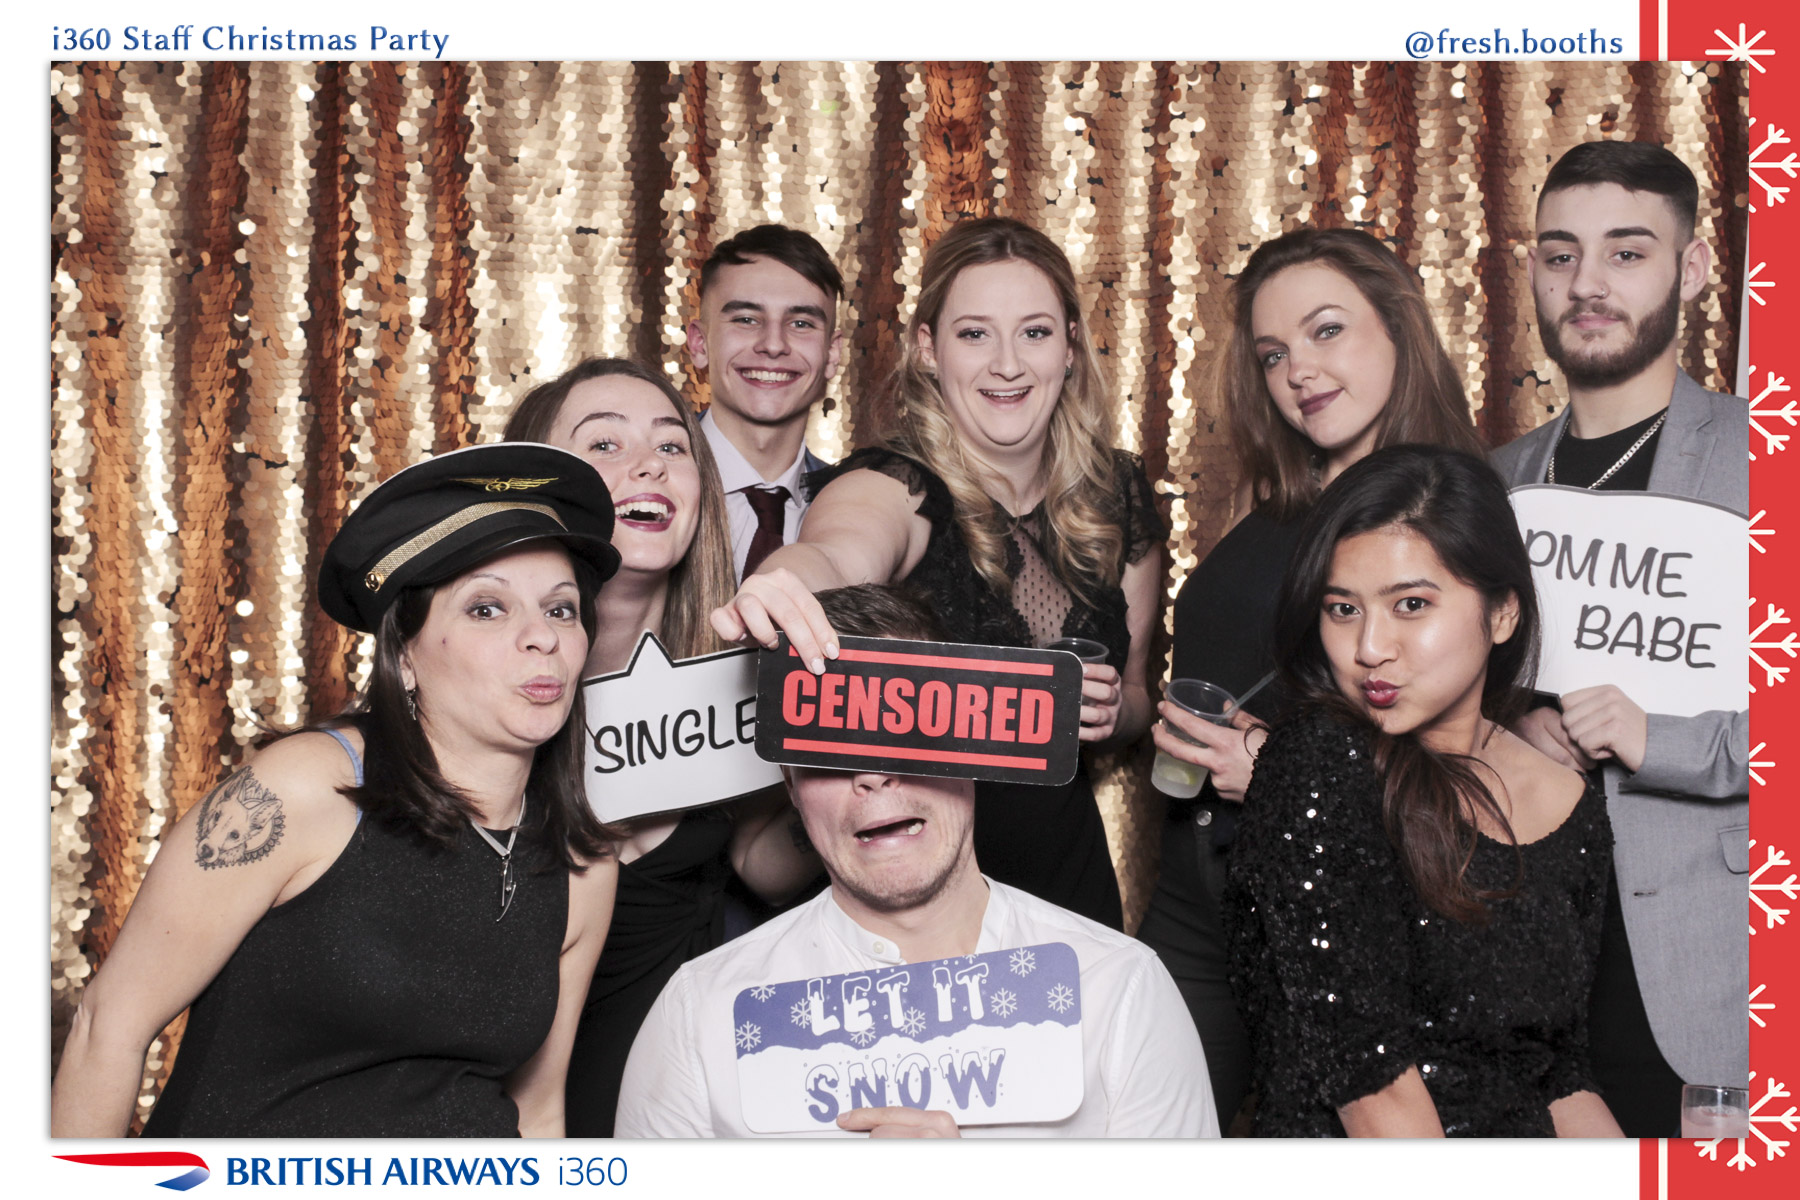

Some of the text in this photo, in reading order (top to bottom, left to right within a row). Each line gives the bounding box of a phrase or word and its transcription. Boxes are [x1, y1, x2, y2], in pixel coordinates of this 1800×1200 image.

[1609, 542, 1693, 598] ME
[1574, 604, 1722, 669] BABE
[594, 695, 757, 774] SINGLE
[782, 669, 1055, 746] CENSORED
[807, 962, 989, 1037] LET IT
[805, 1047, 1006, 1123] SNOW
